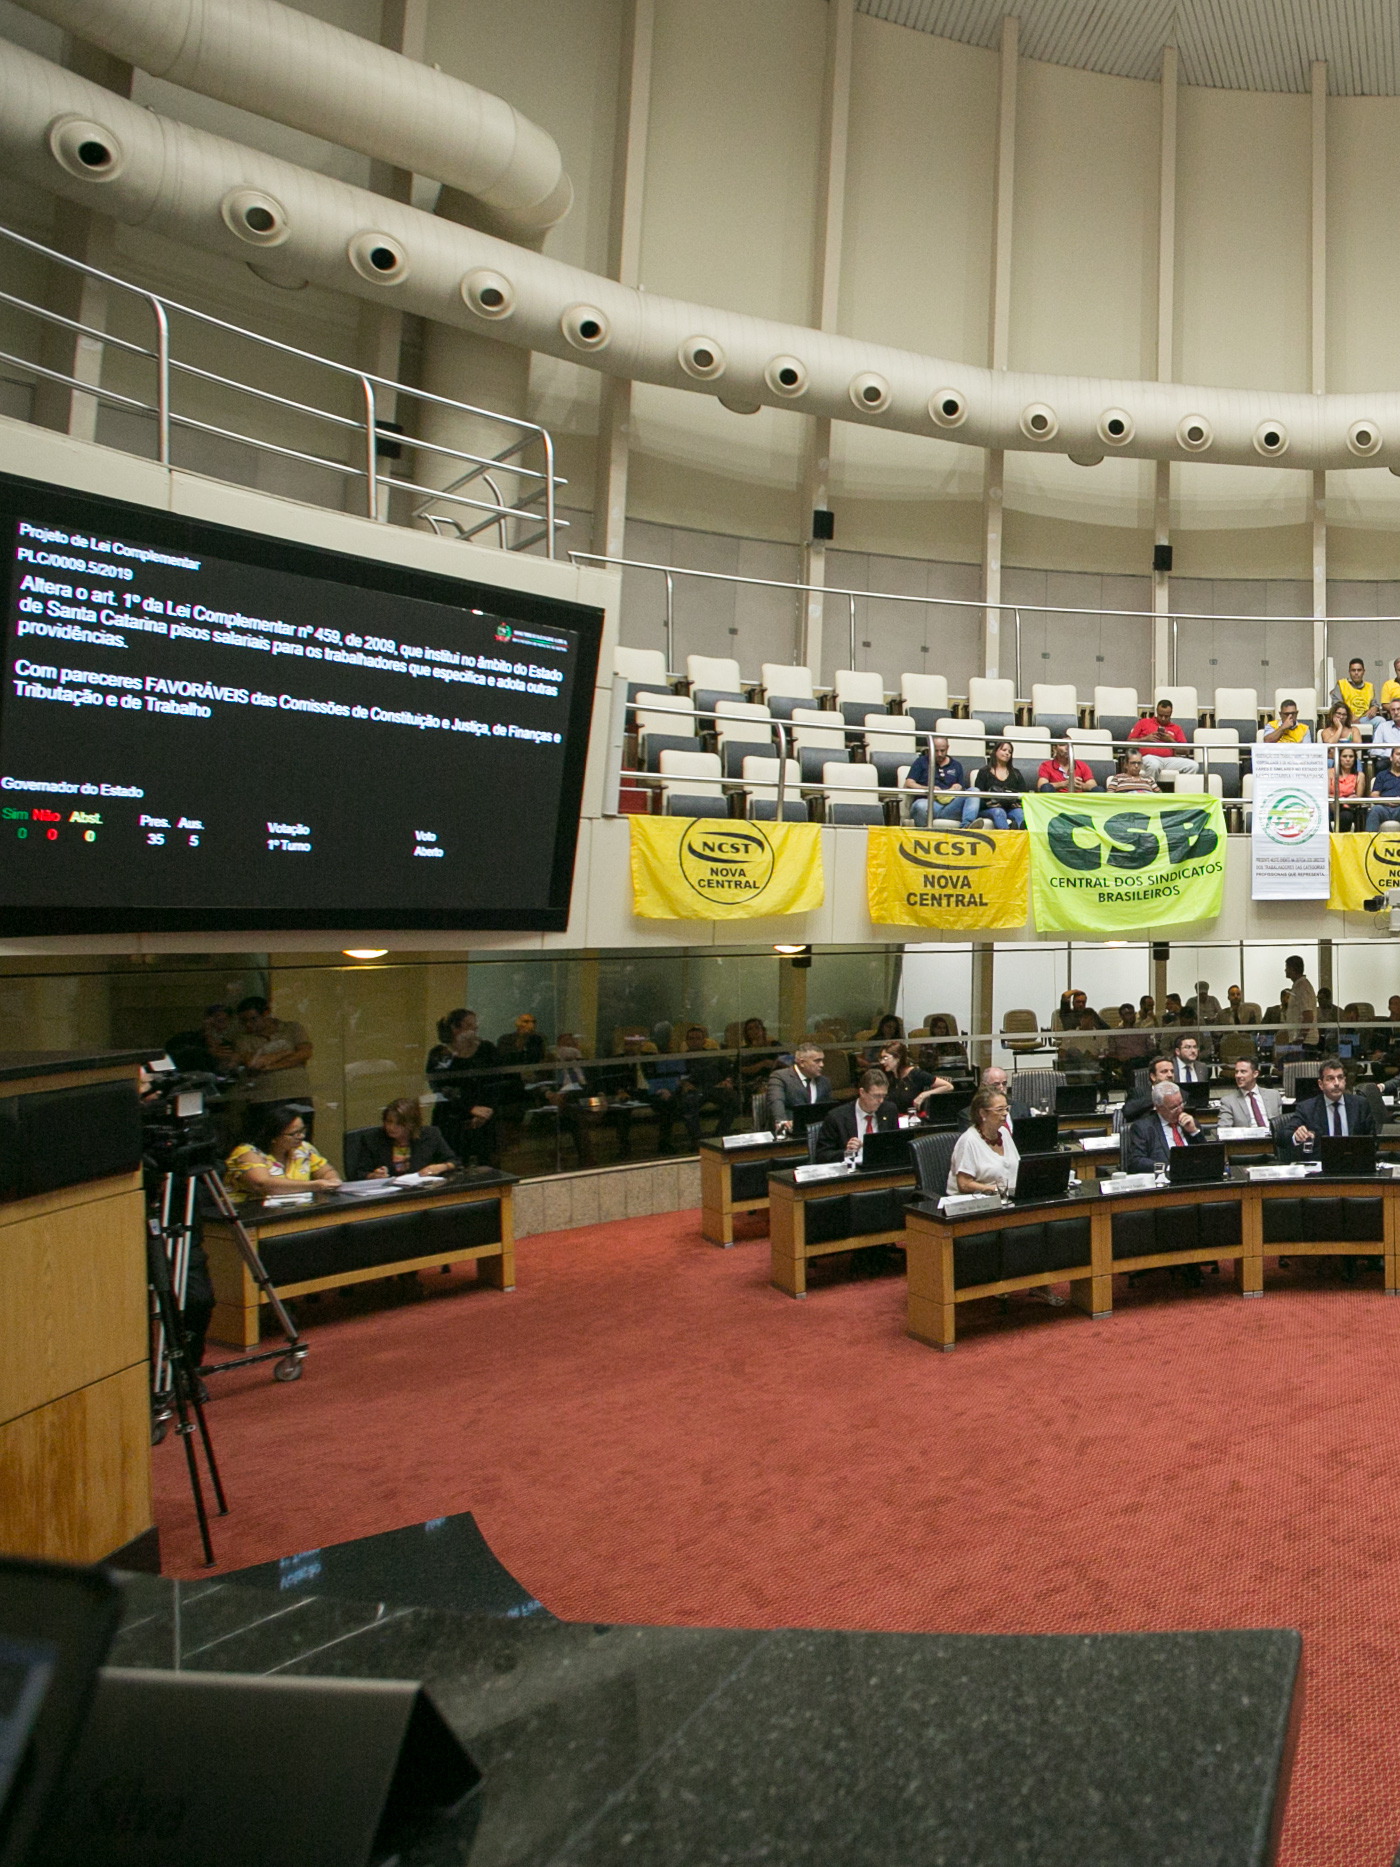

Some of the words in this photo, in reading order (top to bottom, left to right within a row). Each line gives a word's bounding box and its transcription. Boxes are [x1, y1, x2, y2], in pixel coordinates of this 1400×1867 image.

[19, 522, 69, 545] Projeto
[70, 533, 89, 549] de
[90, 537, 111, 552] Lei
[112, 542, 201, 571] Complementar
[17, 547, 134, 581] PLC/0009.5/2019
[17, 619, 129, 649] providências.
[20, 574, 73, 599] Altera
[75, 586, 89, 600] o
[90, 589, 118, 606] art.
[123, 592, 141, 609] 1º
[142, 597, 164, 614] da
[166, 600, 191, 619] Lei
[192, 605, 297, 638] Complementar
[297, 624, 314, 639] nº
[313, 627, 343, 646] 459,
[345, 632, 363, 648] de
[363, 636, 399, 656] 2009,
[400, 643, 423, 660] que
[424, 645, 460, 664] institui
[461, 654, 476, 668] no
[477, 655, 512, 674] âmbito
[513, 662, 527, 677] do
[528, 665, 564, 682] Estado
[19, 597, 44, 614] de
[46, 600, 98, 623] Santa
[100, 609, 168, 635] Catarina
[170, 621, 211, 641] pisos
[212, 628, 271, 651] salariais
[272, 637, 304, 657] para
[305, 645, 322, 660] os
[324, 647, 408, 674] trabalhadores
[408, 664, 431, 678] que
[432, 666, 486, 686] especifica
[487, 674, 496, 687] e
[496, 674, 526, 692] adota
[526, 680, 558, 697] outras
[13, 679, 103, 706] Tributação
[105, 693, 119, 708] e
[120, 694, 143, 711] de
[144, 695, 212, 719] Trabalho
[14, 659, 58, 680] Com
[59, 667, 143, 691] pareceres
[144, 675, 250, 704] FAVORÁVEIS
[250, 692, 278, 708] das
[278, 693, 351, 718] Comissões
[351, 704, 369, 720] de
[369, 706, 440, 730] Constituição
[441, 716, 451, 729] e
[451, 718, 491, 738] Justiça,
[492, 723, 508, 737] de
[508, 725, 553, 745] Finanças
[553, 732, 562, 743] e
[0, 776, 80, 794] Governador
[80, 783, 99, 795] do
[100, 783, 145, 799] Estado
[1, 807, 29, 821] Sim
[31, 809, 61, 822] Não
[69, 811, 103, 825] Abst.
[138, 814, 171, 828] Pres.
[176, 817, 205, 830] Aus.
[266, 822, 311, 836] Votação
[17, 828, 28, 839] 0
[46, 828, 58, 841] 0
[83, 830, 97, 843] 0
[146, 833, 166, 846] 35
[188, 835, 200, 847] 5
[702, 841, 752, 854] NCST
[913, 839, 981, 856] NCST
[1047, 808, 1218, 871] CSB
[697, 878, 760, 889] CENTRAL
[710, 867, 747, 877] NOVA
[923, 874, 972, 889] NOVA
[1050, 877, 1110, 889] CENTRAL
[1114, 876, 1143, 887] DOS
[1147, 861, 1223, 886] SINDICATOS
[906, 892, 988, 907] CENTRAL
[1098, 885, 1181, 903] BRASILEIROS
